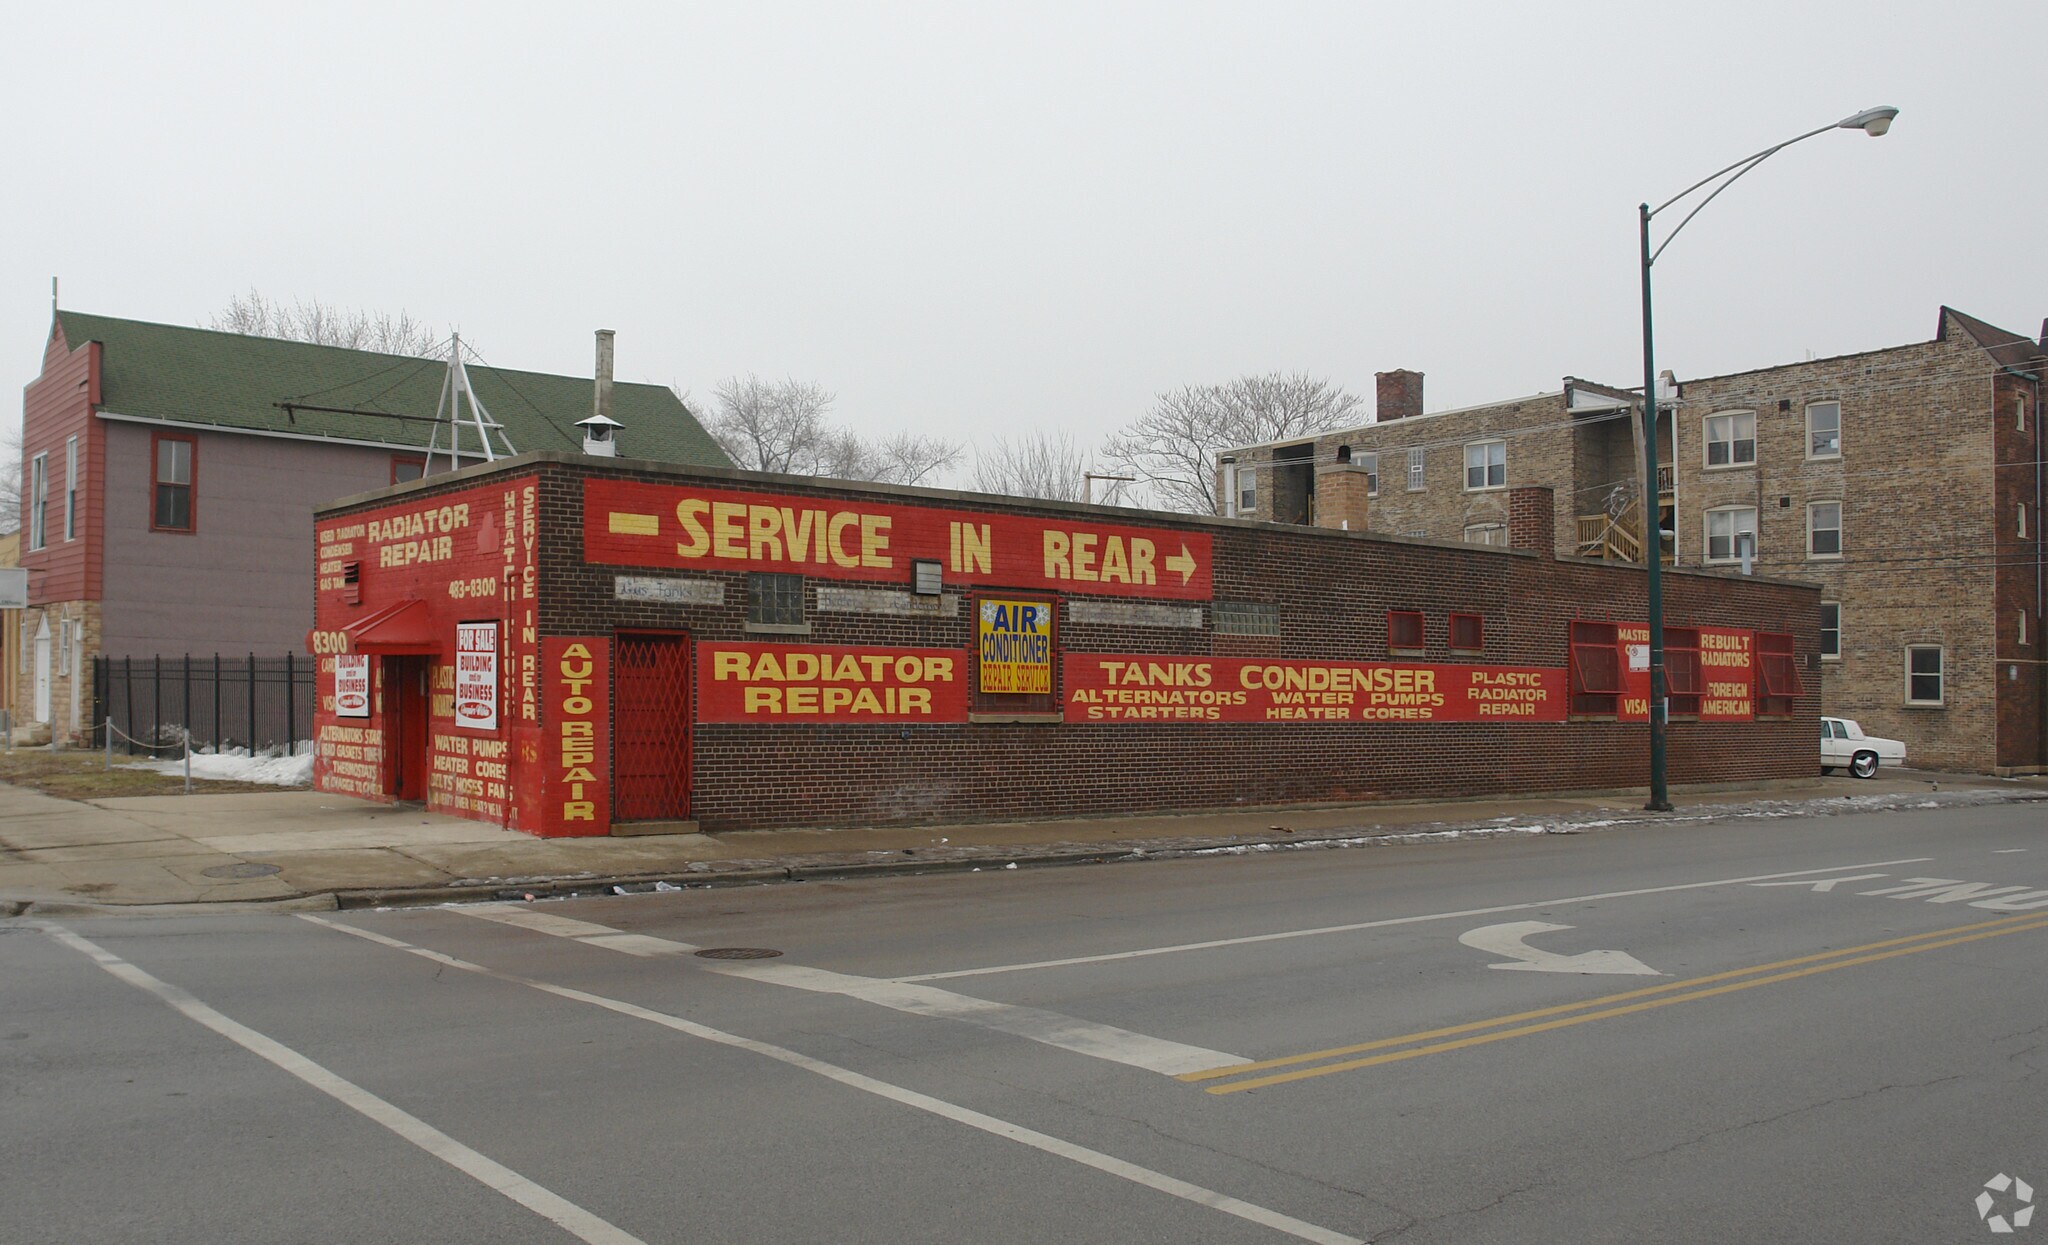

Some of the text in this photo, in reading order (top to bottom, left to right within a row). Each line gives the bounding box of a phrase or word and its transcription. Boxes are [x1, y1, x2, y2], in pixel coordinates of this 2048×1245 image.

[336, 524, 365, 540] RADIATOR
[368, 503, 469, 543] RADIATOR
[676, 498, 1157, 585] SERVICE IN REAR
[380, 535, 452, 567] REPAIR
[320, 577, 331, 590] GAS
[448, 577, 496, 599] 483-8300
[522, 486, 535, 720] SERVICE IN REAR
[993, 604, 1037, 633] AIR
[312, 631, 347, 654] 8300
[459, 629, 496, 652] FOR SALE
[982, 632, 1048, 663] CONDITIONER
[1701, 634, 1750, 651] REBUILT
[338, 654, 365, 669] BUILDING
[460, 655, 492, 672] BUILDING
[713, 651, 955, 683] RADIATOR
[1701, 651, 1750, 667] RADIATORS
[982, 664, 1049, 692] REPAIR SERVICE
[1099, 661, 1212, 687] TANKS
[1240, 665, 1436, 692] CONDENSER
[1471, 671, 1542, 686] PLASTIC
[338, 678, 366, 693] BUSINESS
[459, 683, 493, 701] BUSINESS
[1467, 687, 1547, 701] RADIATOR
[1707, 682, 1748, 698] FOREIGN
[744, 686, 933, 714] REPAIR
[1071, 689, 1247, 705] ALTERNATORS
[1271, 691, 1446, 707] WATER PUMPS
[1087, 706, 1220, 720] STARTERS
[1266, 706, 1433, 720] HEATER CORES
[1479, 703, 1536, 716] REPAIR
[1623, 699, 1647, 714] VISA
[1702, 700, 1751, 715] AMERICAN
[320, 725, 363, 743] ALTERNATORS
[559, 642, 598, 821] AUTO REPAIR
[336, 744, 362, 761] GASKETS
[434, 734, 468, 755] WATER
[472, 739, 508, 759] PUMPS
[333, 760, 377, 780] THERMOSTATS
[433, 755, 507, 781] HEATER CORES
[331, 776, 355, 791] CHARGE
[456, 777, 484, 797] HOSES
